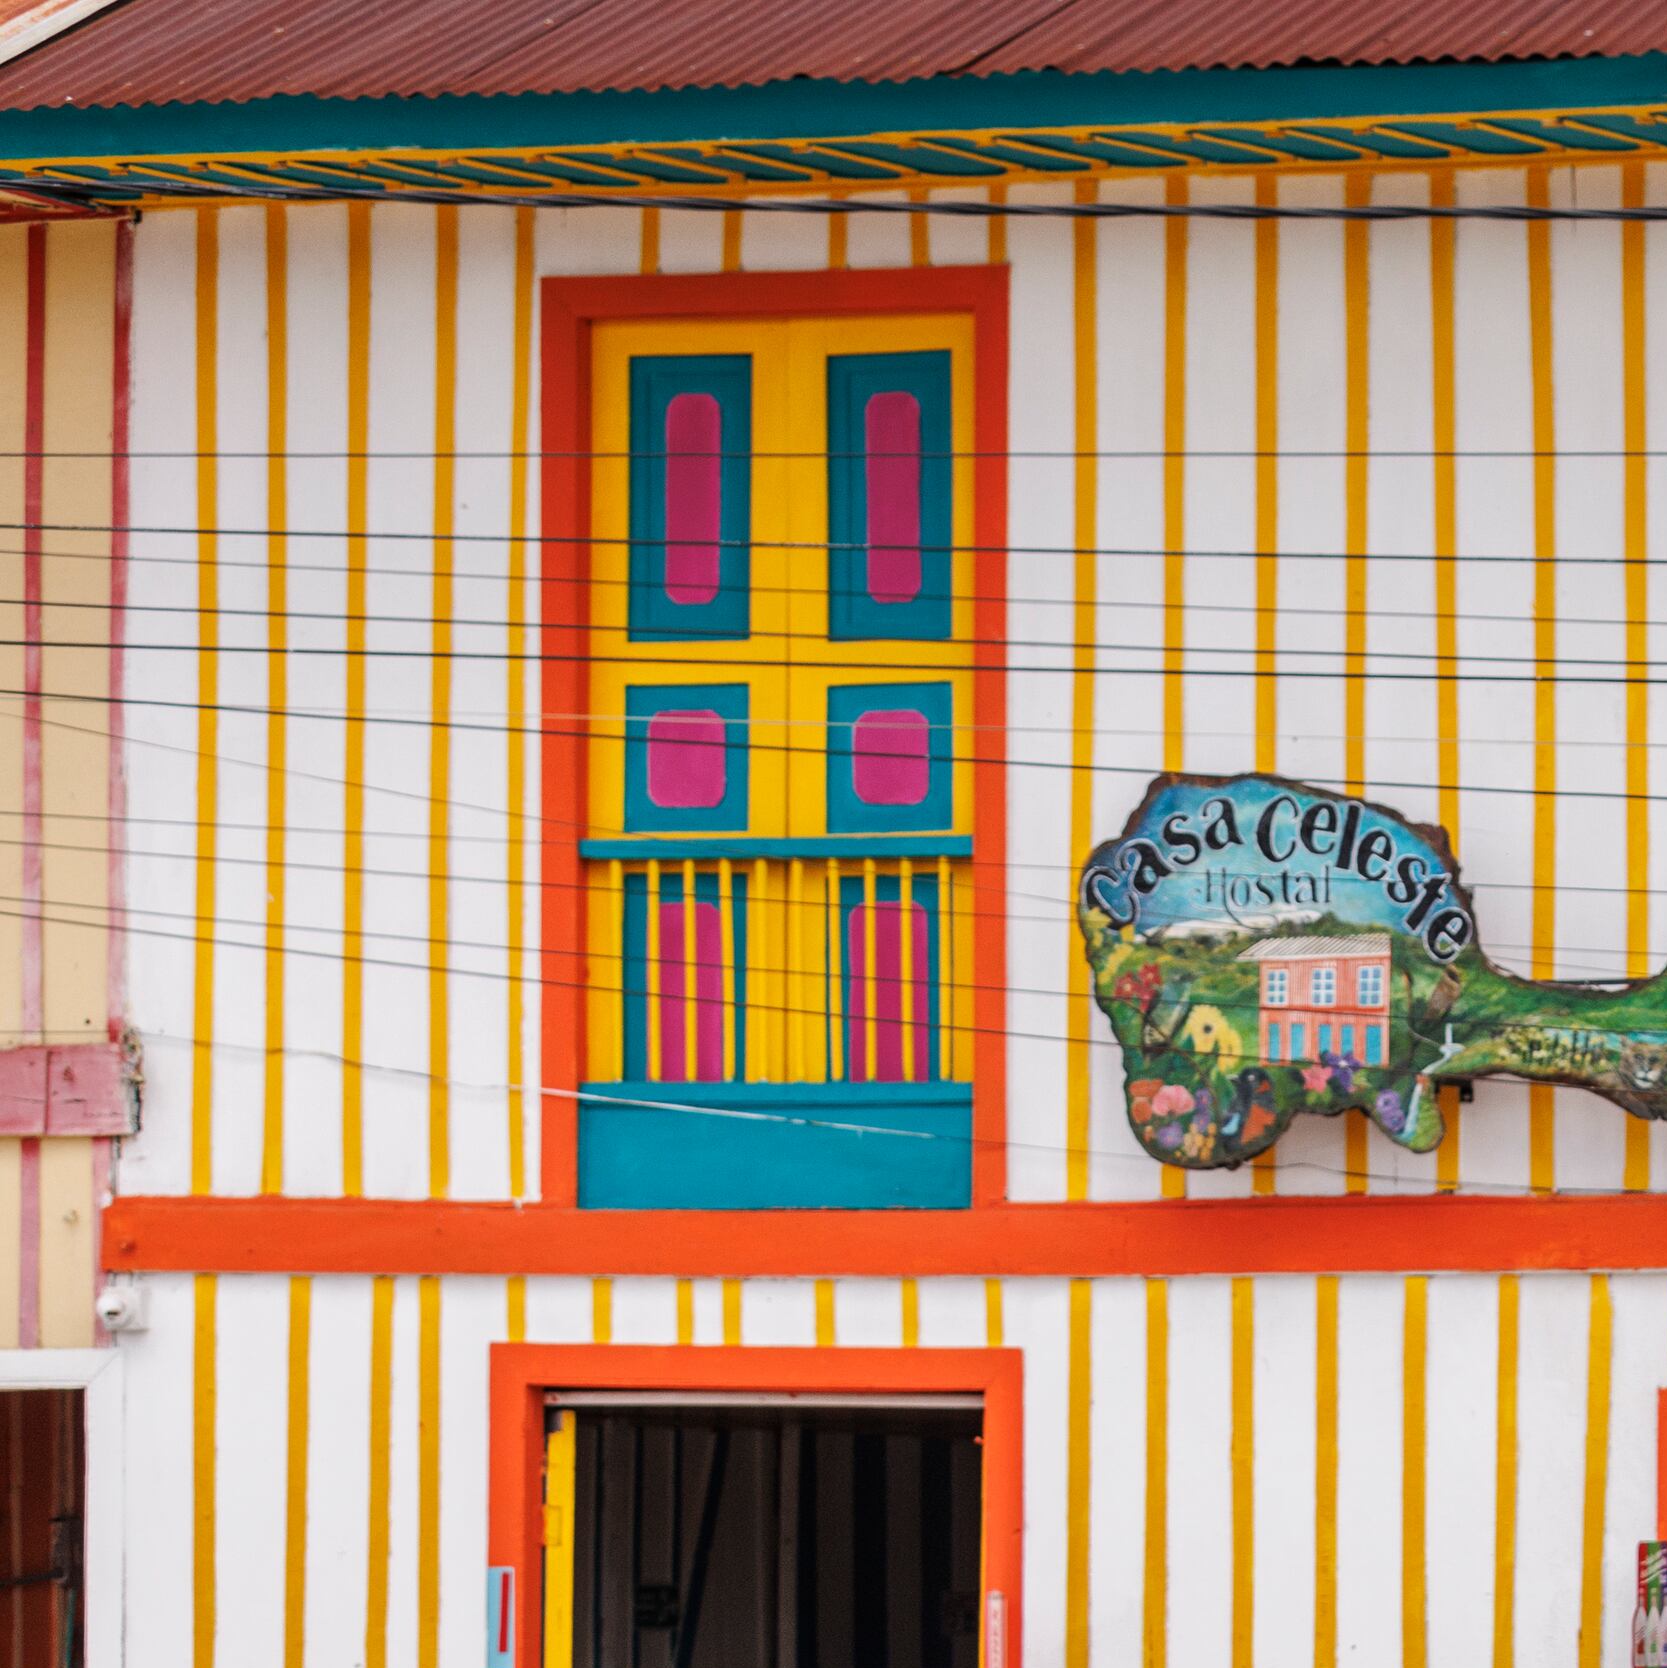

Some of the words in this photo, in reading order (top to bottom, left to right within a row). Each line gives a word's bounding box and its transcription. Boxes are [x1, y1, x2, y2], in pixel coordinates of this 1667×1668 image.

[1083, 796, 1244, 931] Casa
[1256, 795, 1473, 964] Celeste
[1196, 865, 1332, 924] Hostal
